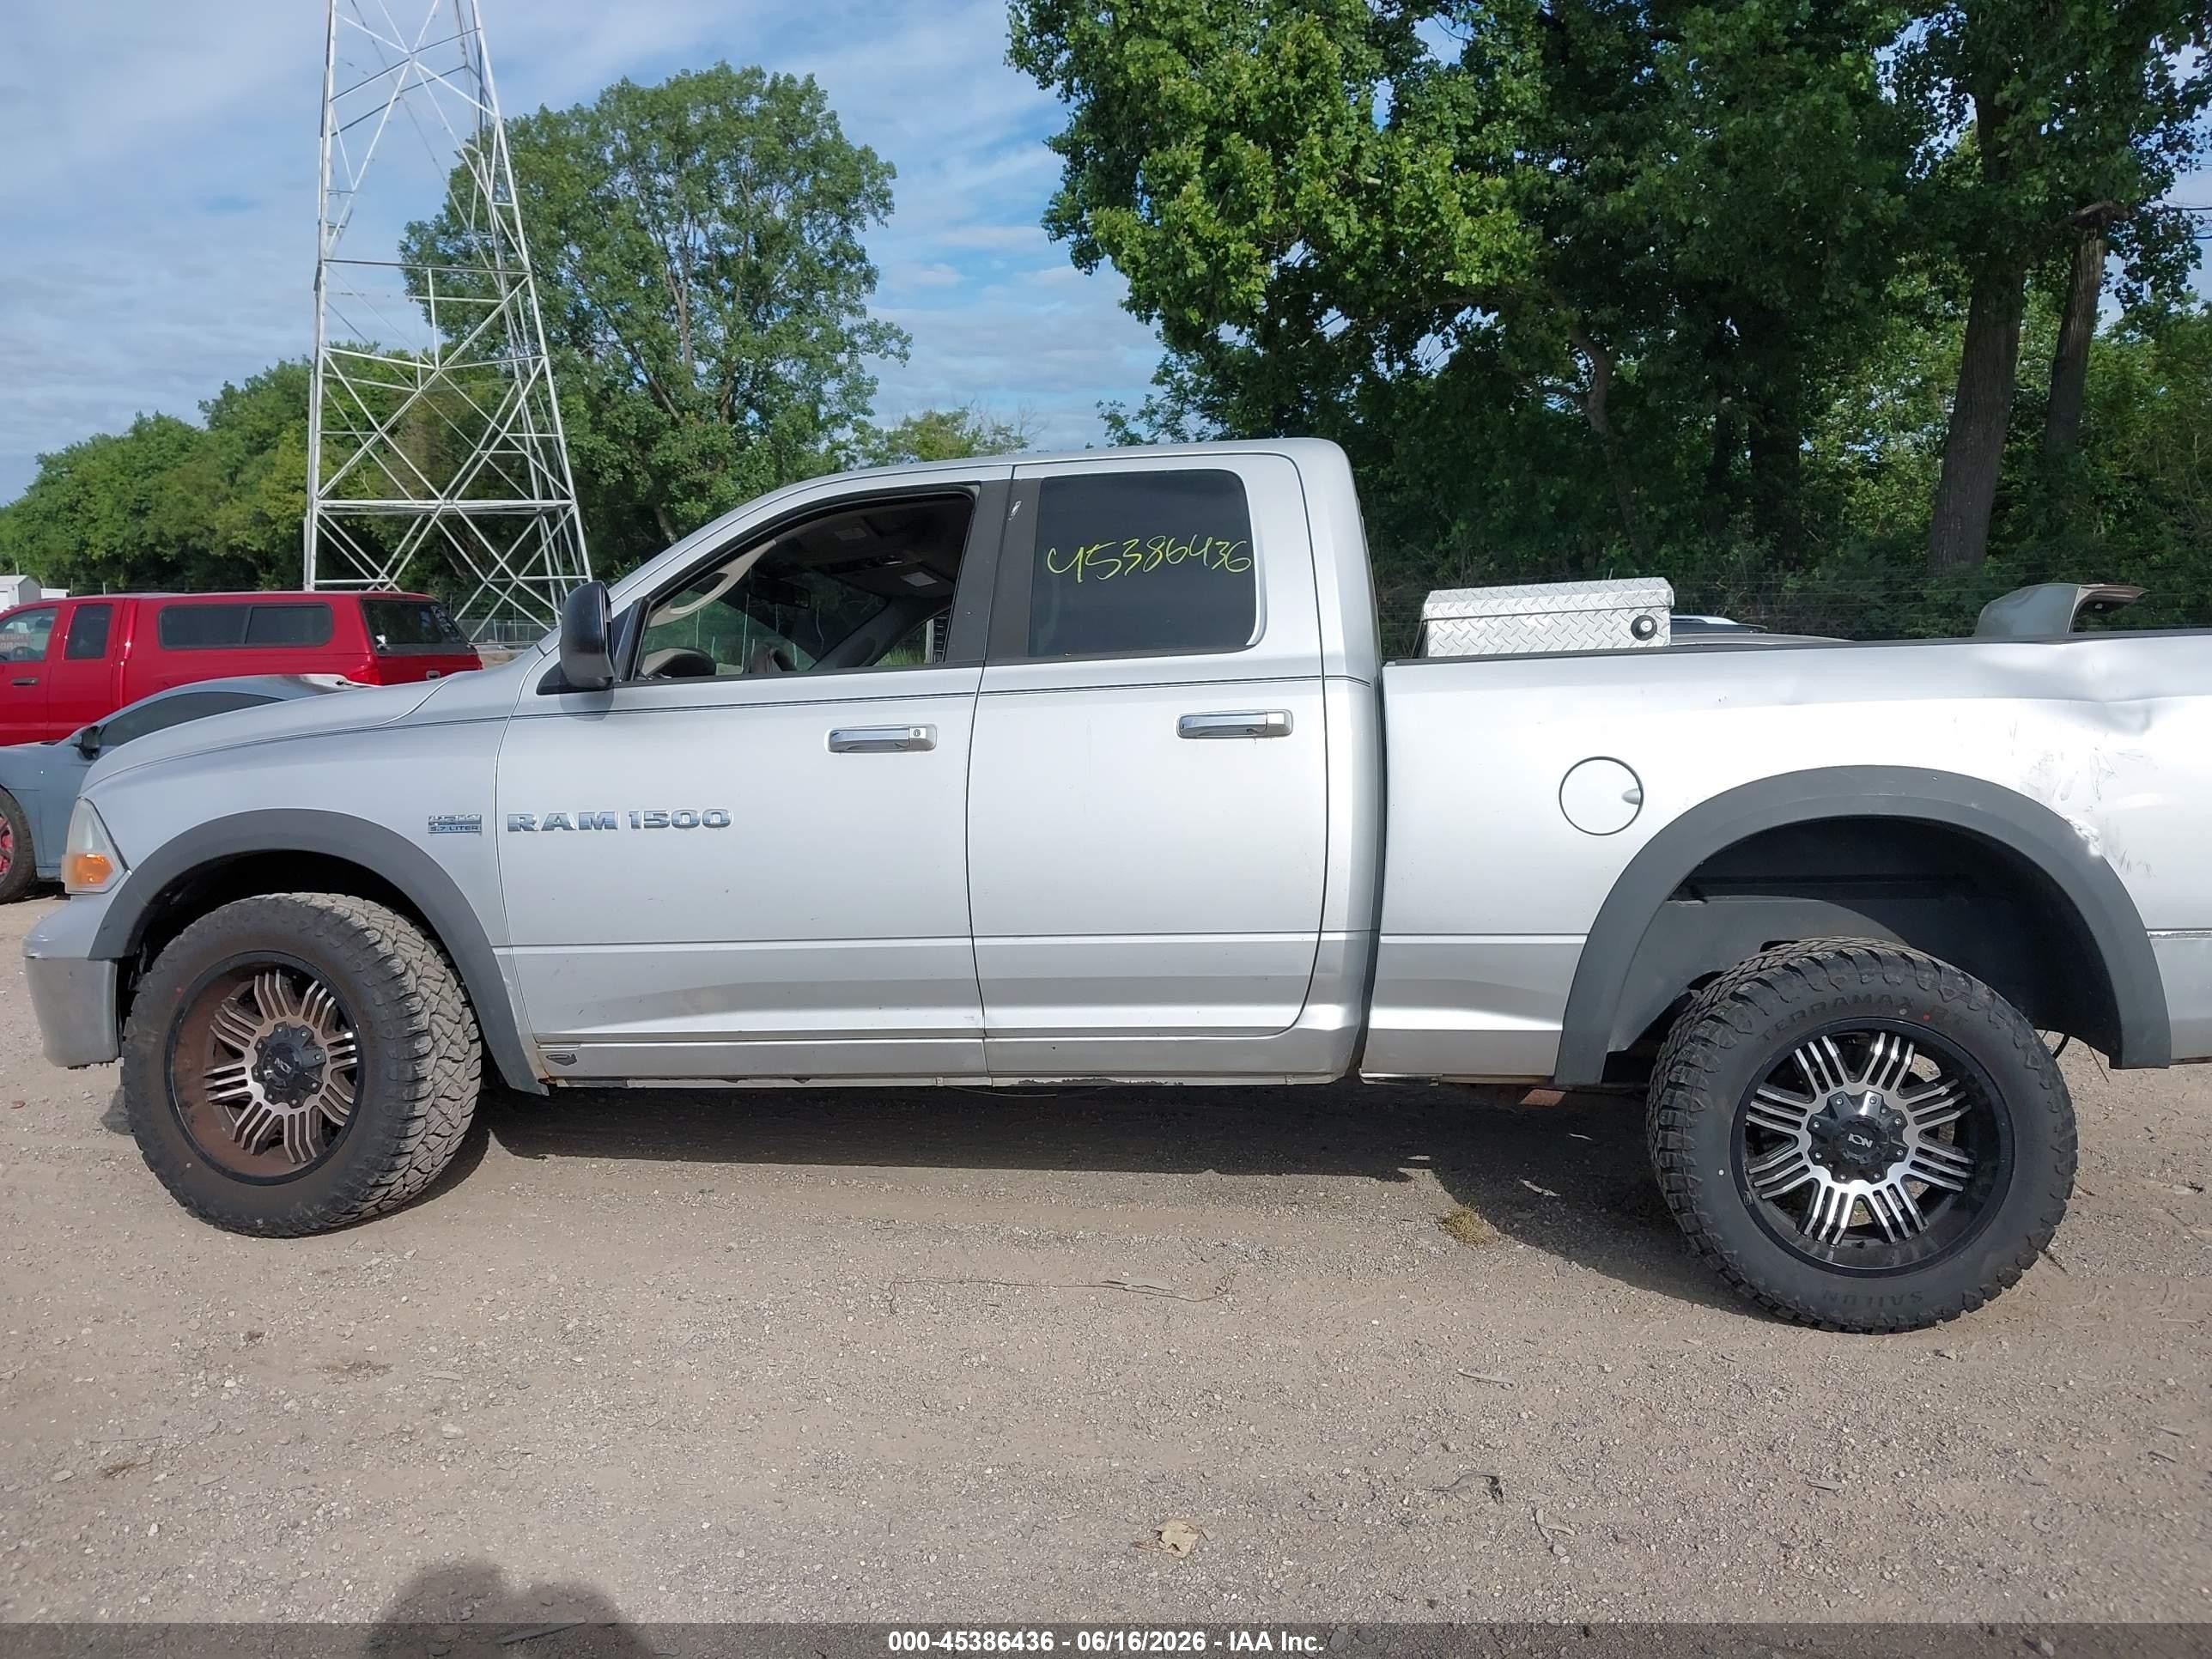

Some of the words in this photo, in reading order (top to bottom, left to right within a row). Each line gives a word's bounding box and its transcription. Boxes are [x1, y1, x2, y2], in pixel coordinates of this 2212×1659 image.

[1046, 533, 1252, 584] 45386436
[507, 811, 618, 832] RAM
[629, 808, 732, 830] 1500
[1848, 1133, 1873, 1148] ION
